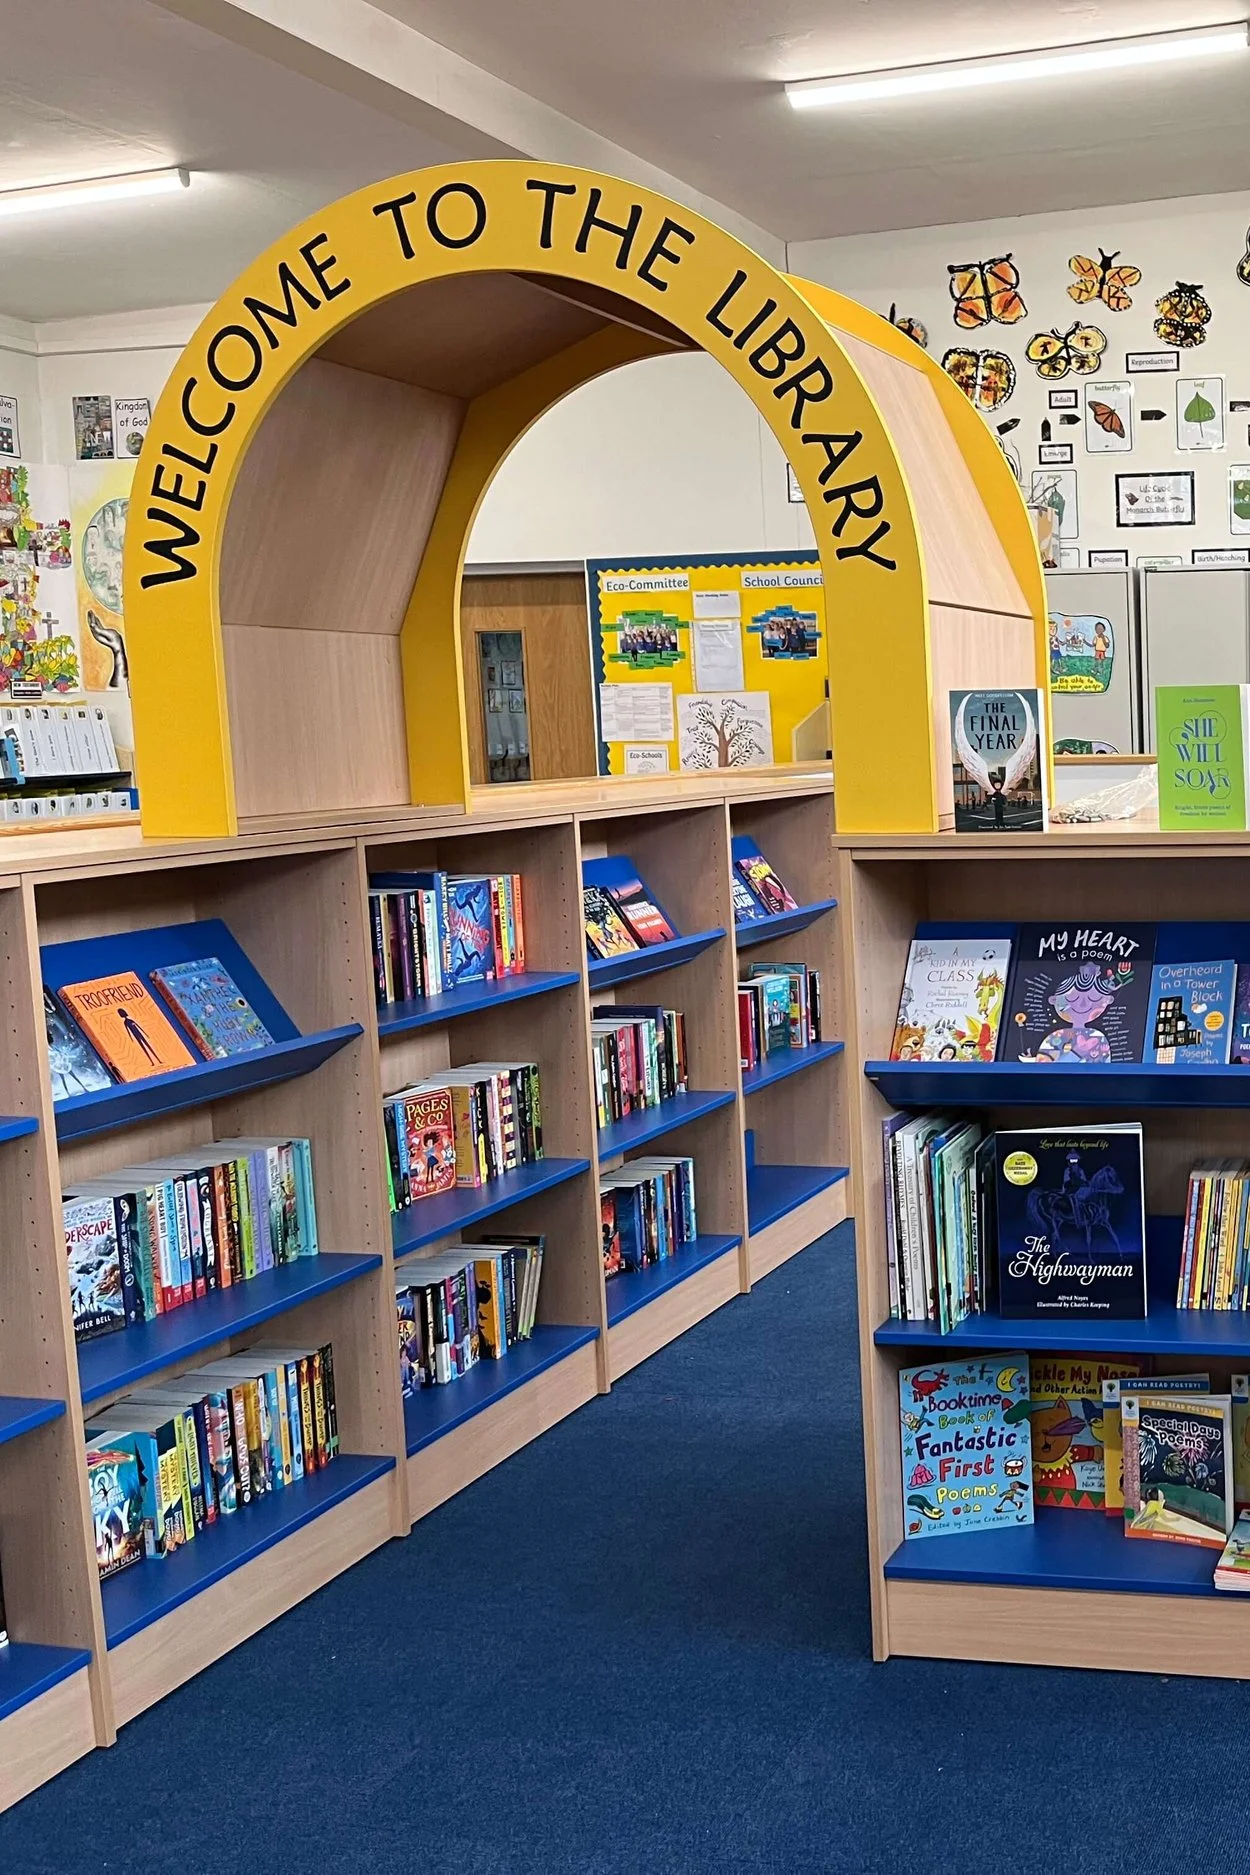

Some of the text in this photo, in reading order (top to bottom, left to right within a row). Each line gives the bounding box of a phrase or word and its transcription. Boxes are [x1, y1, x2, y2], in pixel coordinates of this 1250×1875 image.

[1131, 358, 1174, 366] Reproduction
[141, 179, 897, 590] WELCOME TO THE LIBRARY
[120, 418, 148, 426] of God
[1094, 556, 1122, 564] Pupation
[606, 578, 688, 591] Eco-Committee
[744, 574, 823, 587] School Counci
[984, 702, 1006, 713] THE
[970, 715, 1020, 731] FINAL
[975, 733, 1016, 750] YEAR
[1175, 743, 1225, 762] WILL
[1174, 768, 1230, 794] SOAR
[1039, 929, 1140, 958] MY HEART
[930, 959, 977, 968] KID IN MY
[1057, 950, 1113, 962] is poem
[927, 969, 974, 983] CLASS
[1159, 964, 1222, 979] Overheard
[1185, 978, 1219, 989] Tower
[75, 983, 144, 1011] TROOFRIEND
[1191, 991, 1223, 1002] Block
[1180, 1049, 1212, 1058] Joseph
[406, 1098, 448, 1120] PAGES
[414, 1116, 426, 1130] &
[1080, 1140, 1099, 1149] beyond
[906, 1164, 920, 1270] Treasury Children's Poems
[1024, 1235, 1050, 1254] The
[1008, 1250, 1133, 1285] Highwayman
[96, 1315, 111, 1326] BELL
[952, 1375, 976, 1386] The
[1070, 1366, 1091, 1383] My
[1045, 1385, 1097, 1394] Other Action
[928, 1392, 1002, 1413] Booktime
[939, 1410, 994, 1429] Book of
[1142, 1416, 1221, 1440] Special Days
[915, 1426, 1017, 1460] Fantastic
[1158, 1429, 1203, 1449] Poems
[939, 1454, 994, 1482] First
[936, 1482, 998, 1504] Poems
[927, 1518, 981, 1531] Edited June
[121, 1550, 141, 1566] DEAN
